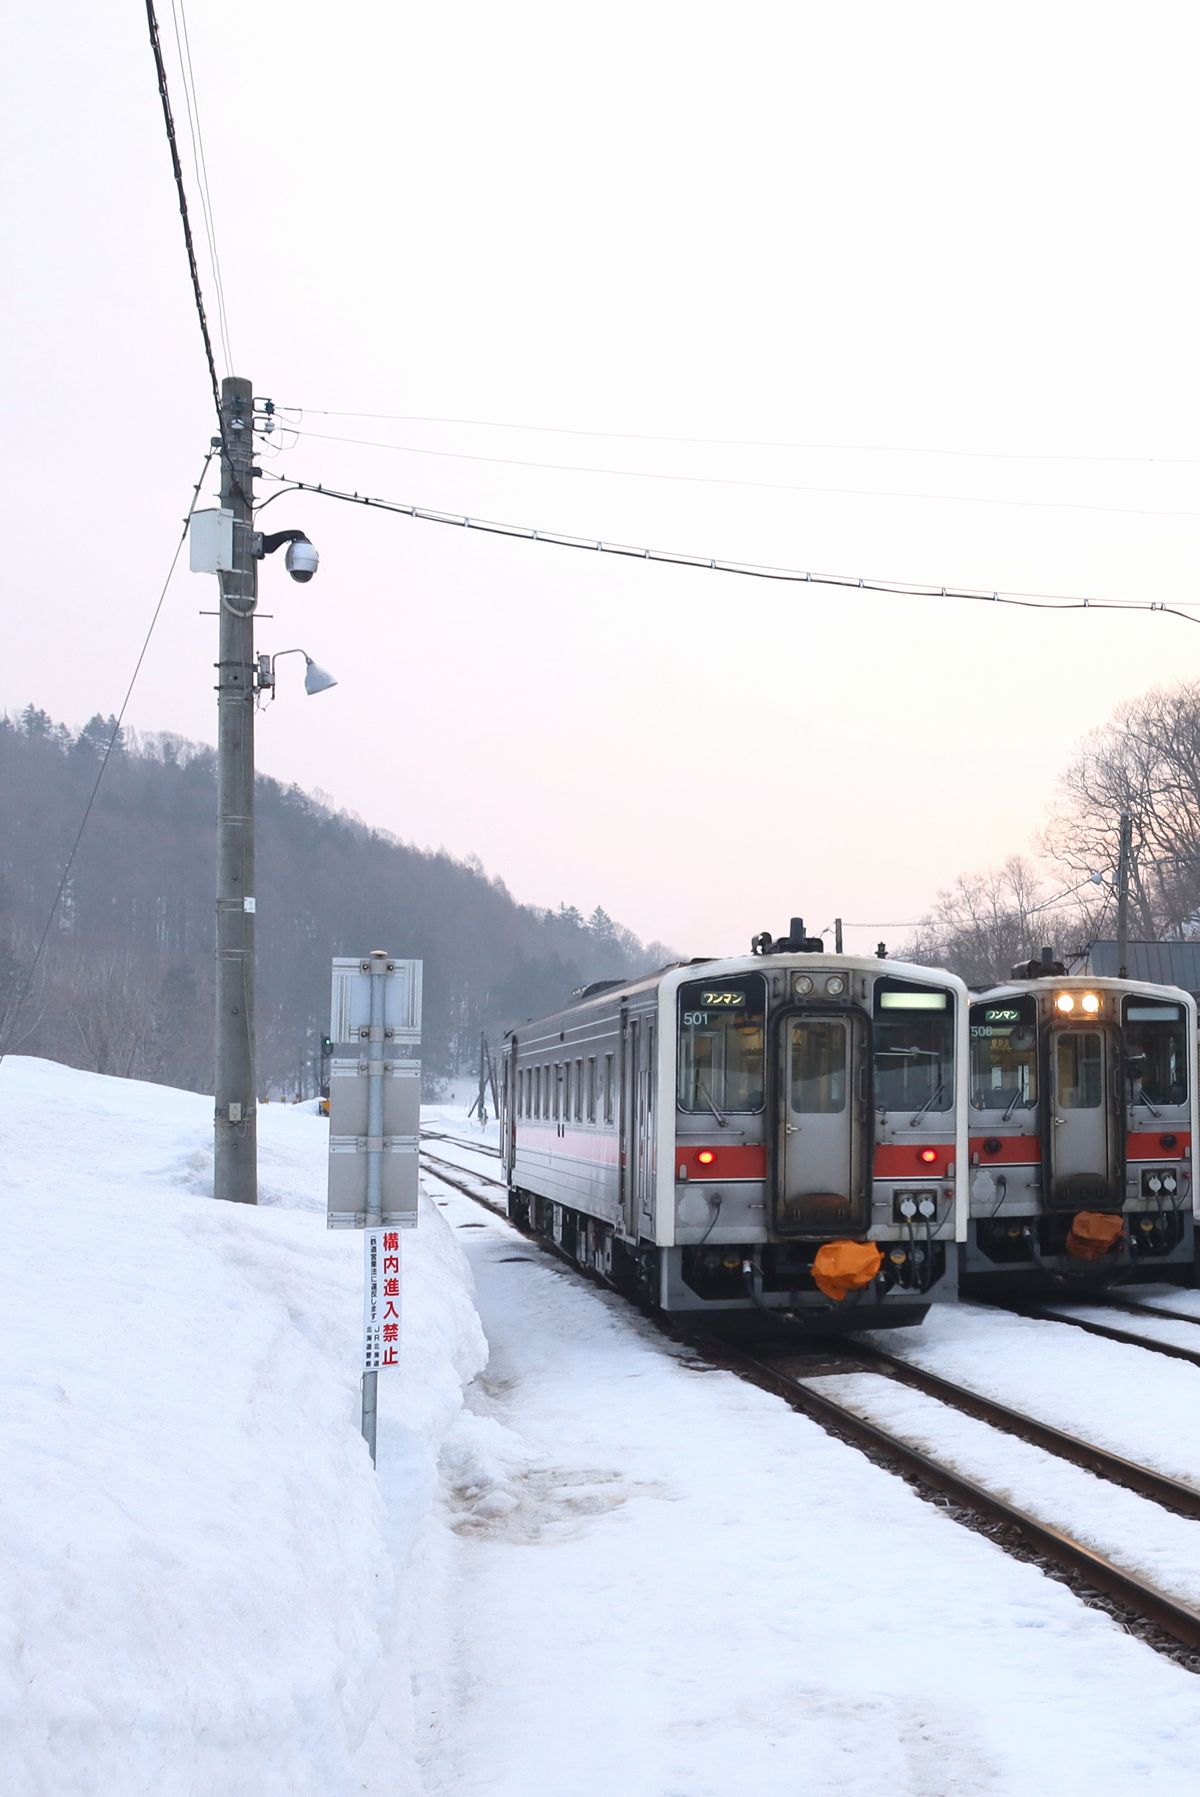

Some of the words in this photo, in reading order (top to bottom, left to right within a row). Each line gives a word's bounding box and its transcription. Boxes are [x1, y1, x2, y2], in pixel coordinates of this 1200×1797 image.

[703, 992, 742, 1004] ワンマン
[683, 1012, 708, 1025] 501
[987, 1010, 1018, 1019] ワンマン
[970, 1025, 993, 1037] 506
[382, 1231, 399, 1365] 構内進入禁止
